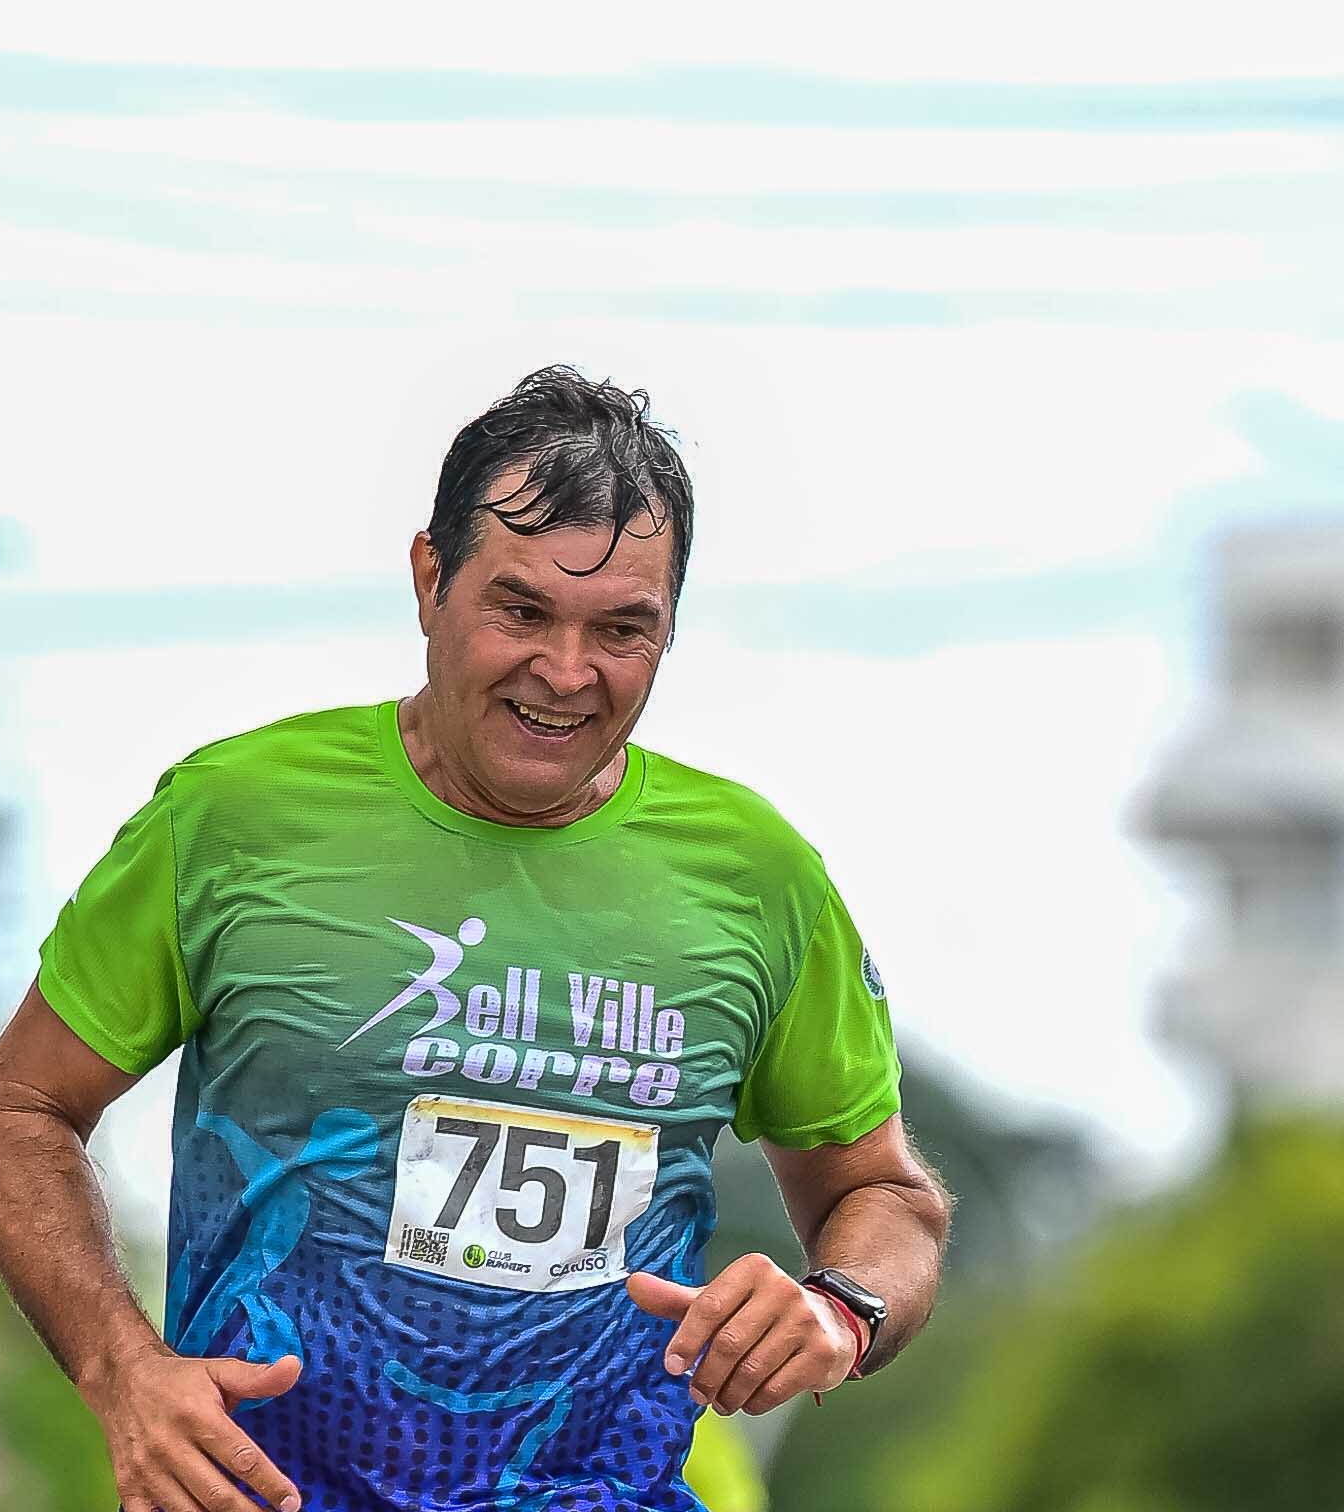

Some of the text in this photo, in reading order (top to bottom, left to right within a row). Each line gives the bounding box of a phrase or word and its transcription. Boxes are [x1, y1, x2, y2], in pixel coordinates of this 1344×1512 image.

[568, 972, 686, 1059] Ville
[401, 1036, 681, 1107] corre
[434, 1117, 621, 1251] 751
